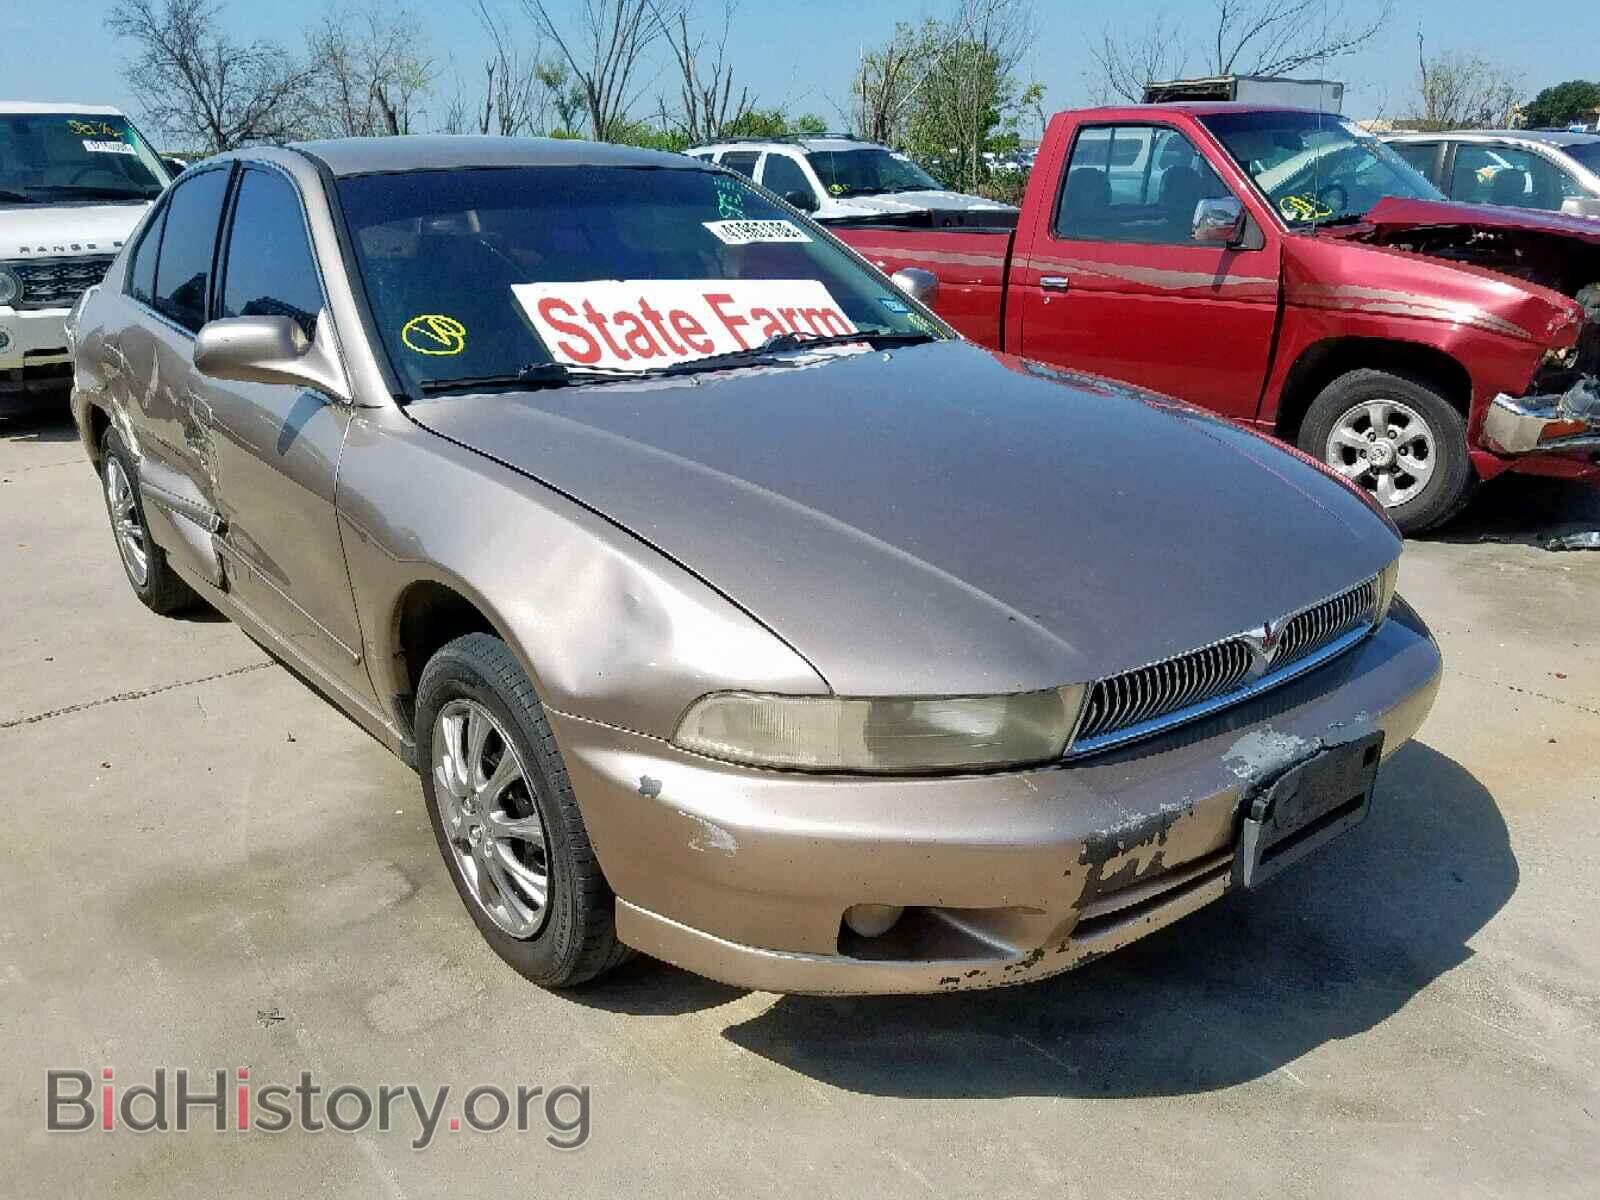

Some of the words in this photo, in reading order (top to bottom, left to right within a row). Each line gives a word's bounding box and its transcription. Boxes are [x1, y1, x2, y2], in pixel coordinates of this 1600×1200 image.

[20, 243, 97, 254] RANGE
[538, 296, 715, 364] State
[703, 294, 860, 350] Farm
